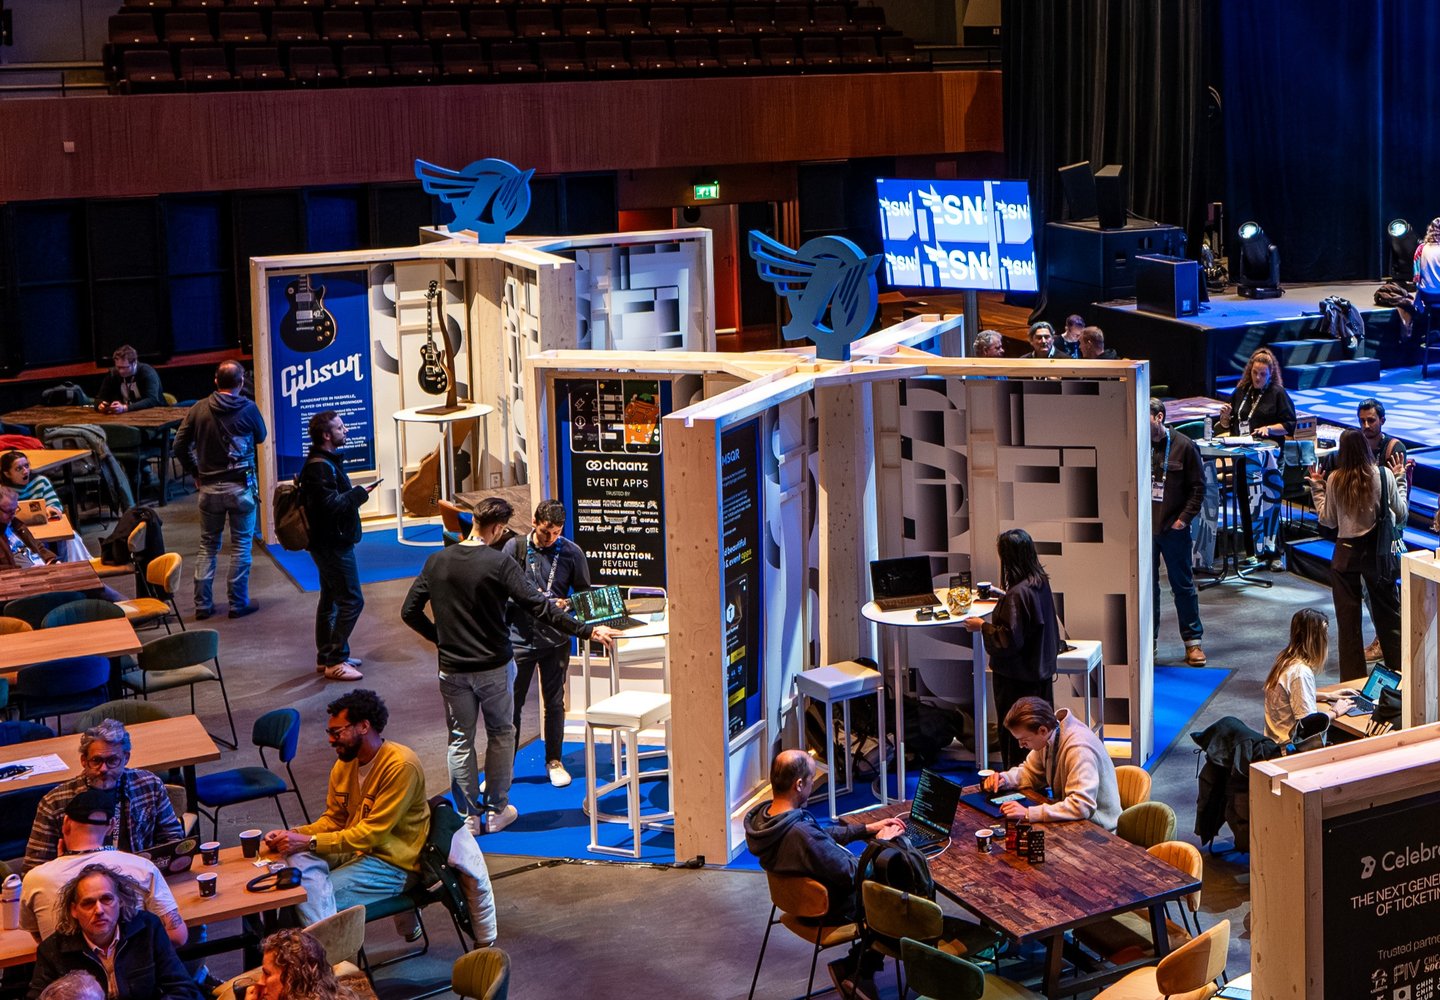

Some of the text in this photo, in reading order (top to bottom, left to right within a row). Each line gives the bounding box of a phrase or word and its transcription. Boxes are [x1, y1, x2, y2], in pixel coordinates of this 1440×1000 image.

[281, 352, 363, 408] Gibson
[603, 459, 648, 471] chaanz
[586, 477, 649, 488] EVENT APPS
[603, 543, 636, 551] VISITOR
[585, 551, 655, 560] SATISFACTION.
[602, 560, 638, 568] REVENUE
[600, 568, 642, 576] GROWTH.
[1350, 892, 1375, 910] THE
[1376, 882, 1408, 903] NEXT
[1376, 901, 1393, 917] OF
[1377, 940, 1412, 960] Trusted
[1415, 978, 1434, 991] CHIN
[1415, 984, 1434, 998] CHIN
